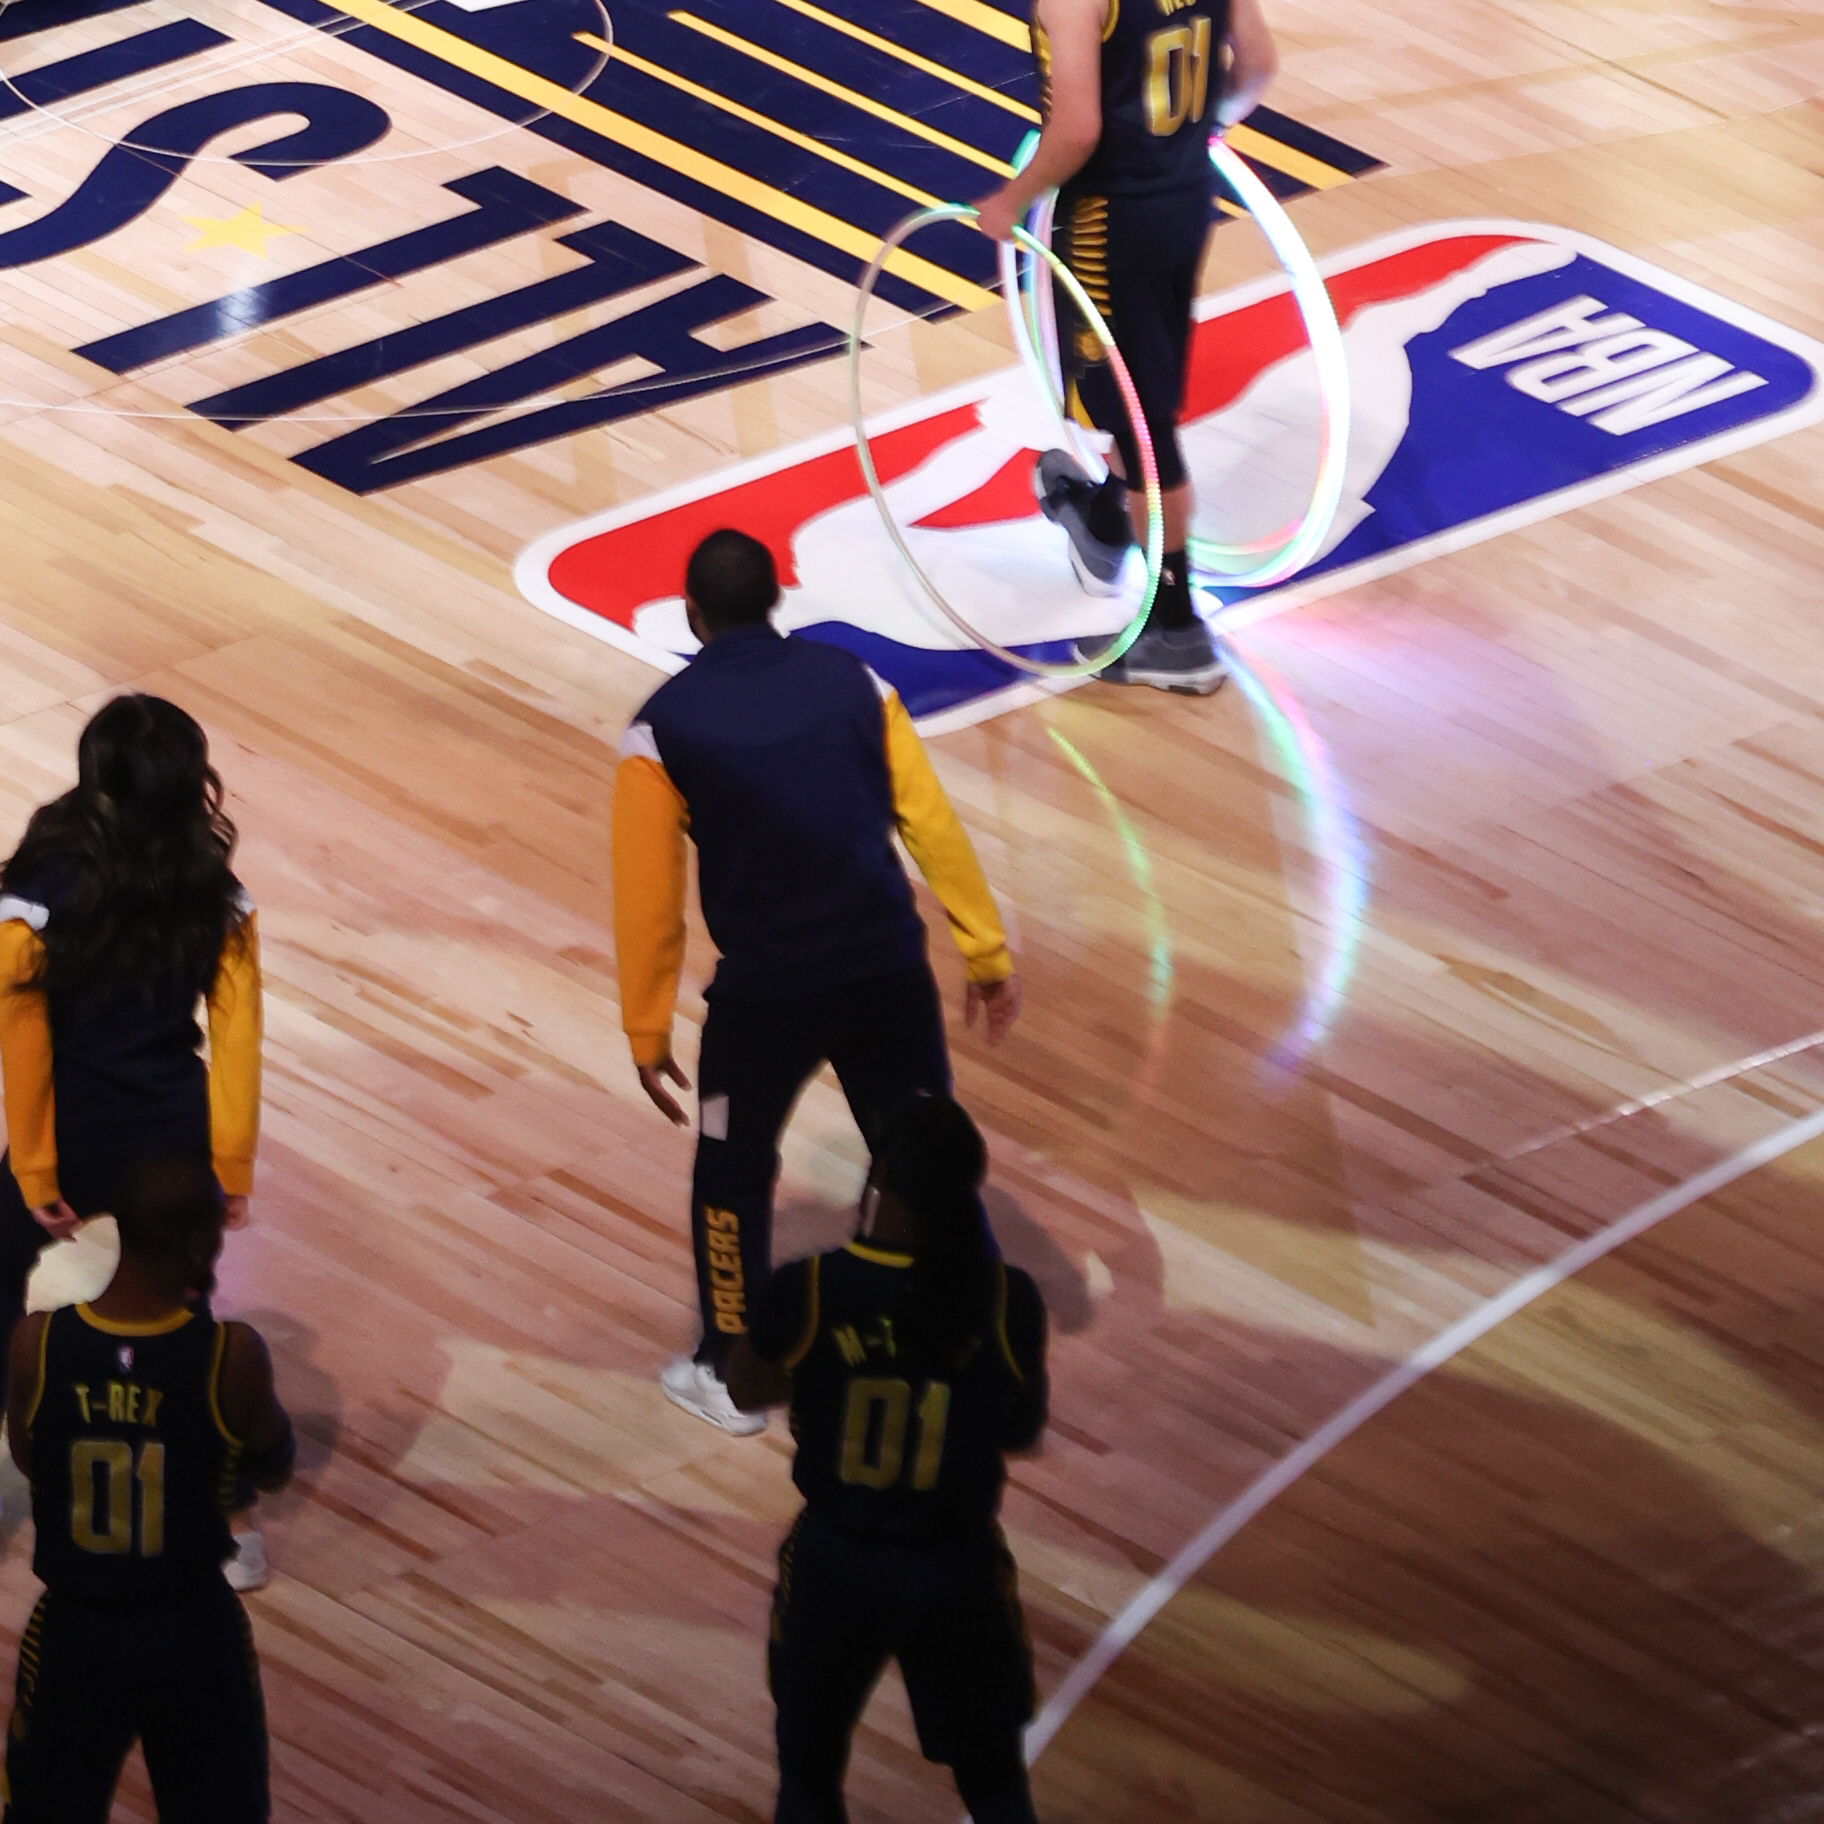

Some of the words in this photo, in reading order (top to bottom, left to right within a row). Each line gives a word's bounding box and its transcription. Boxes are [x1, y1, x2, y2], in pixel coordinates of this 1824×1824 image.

[1143, 15, 1211, 137] 01
[72, 166, 870, 495] ALL
[1446, 294, 1770, 436] NBA
[703, 1203, 751, 1336] PACERS
[74, 1378, 164, 1429] T-REX
[837, 1376, 952, 1492] 01
[70, 1437, 167, 1560] 01
